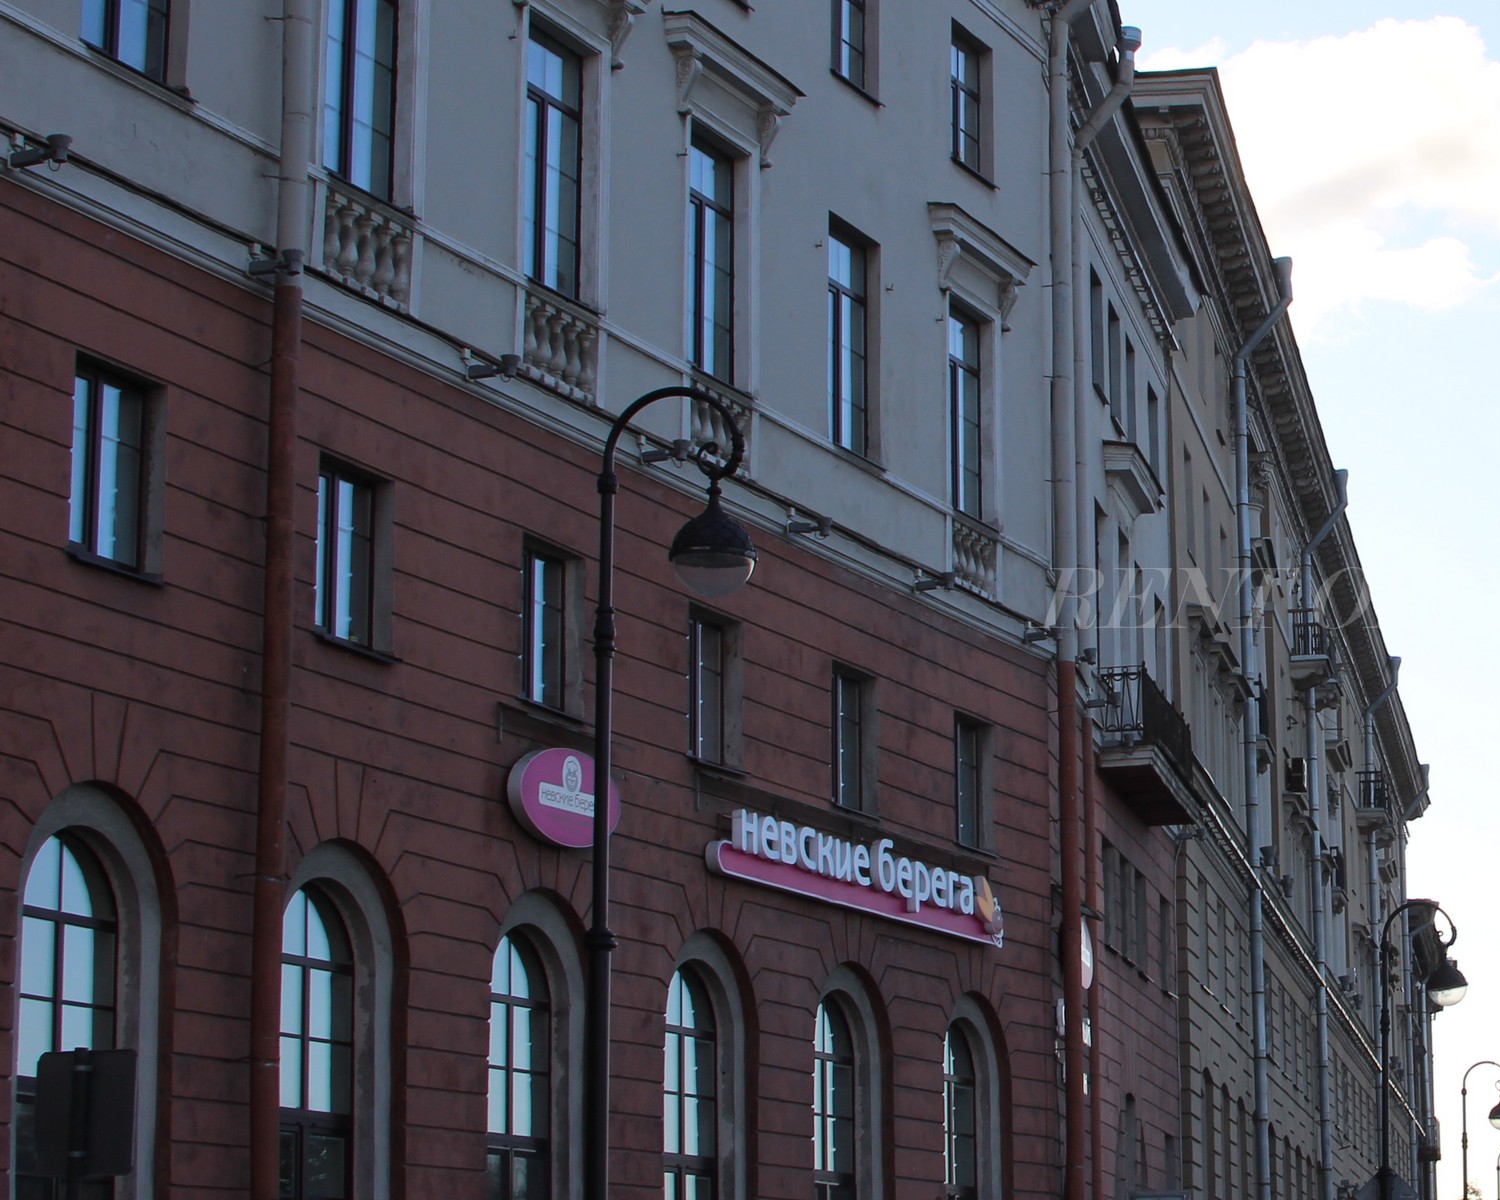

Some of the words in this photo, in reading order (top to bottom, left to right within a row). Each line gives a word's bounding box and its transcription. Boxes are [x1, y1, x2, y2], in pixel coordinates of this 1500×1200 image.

[575, 794, 595, 813] бере
[740, 808, 872, 887] невские
[877, 838, 975, 916] берега
